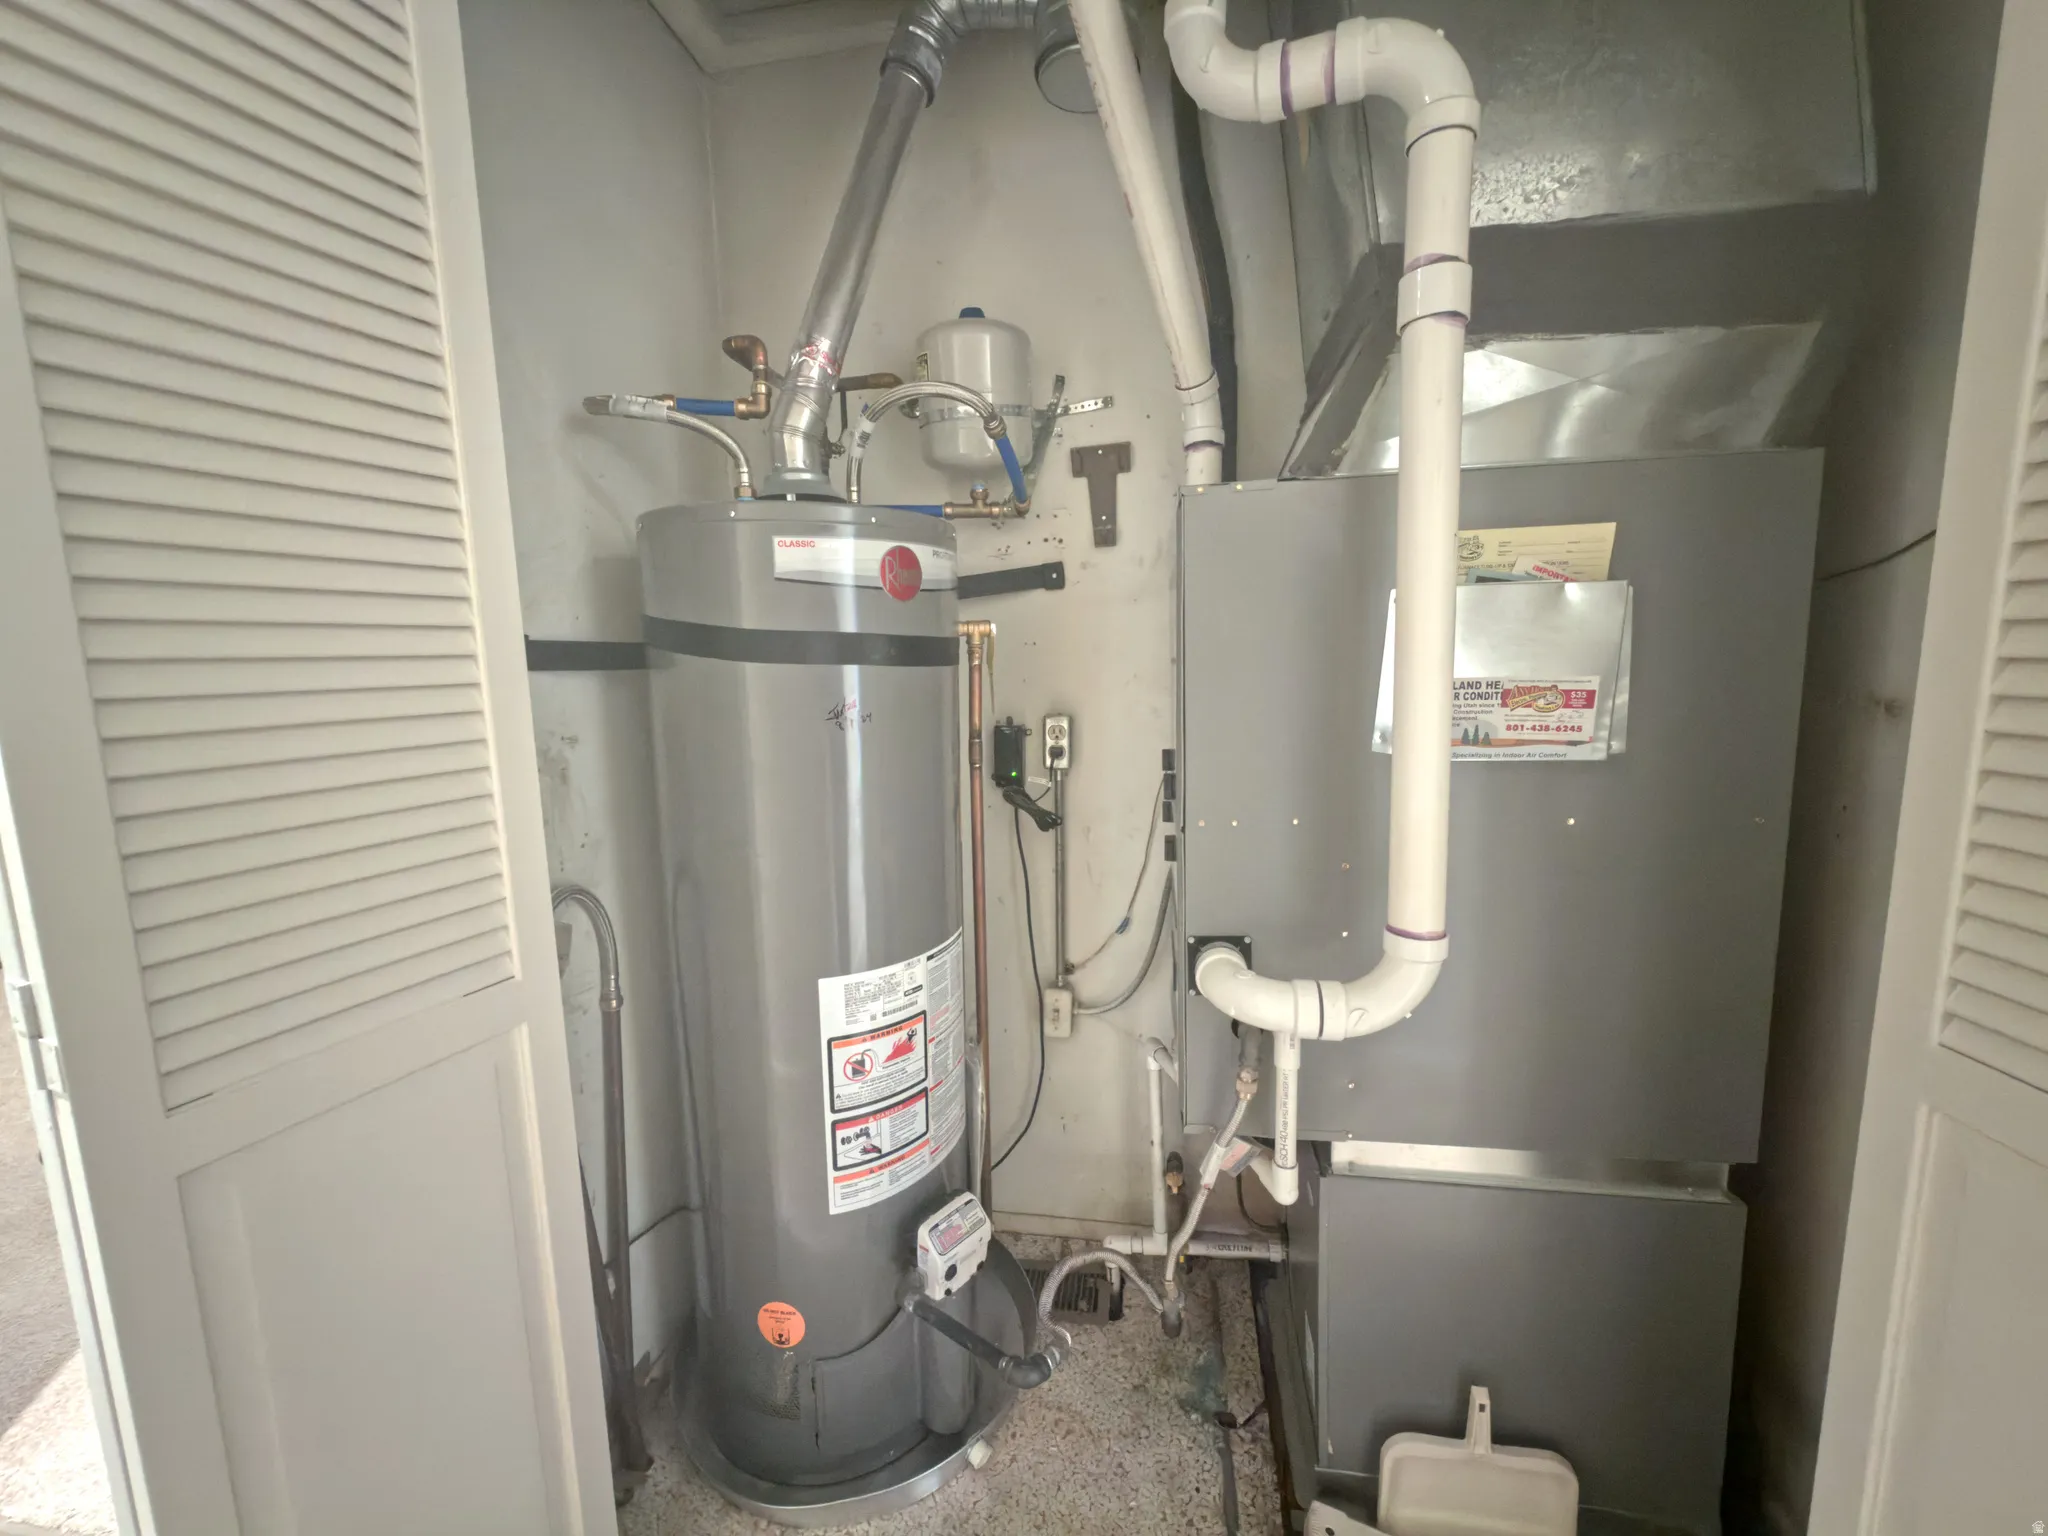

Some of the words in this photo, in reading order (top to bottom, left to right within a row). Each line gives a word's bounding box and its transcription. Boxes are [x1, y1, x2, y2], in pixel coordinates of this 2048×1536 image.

[777, 539, 816, 548] CLASSIC
[1453, 680, 1482, 691] LAND
[1570, 690, 1587, 699] $35
[1505, 723, 1583, 733] 801-438-6245
[1451, 752, 1493, 760] Specializing
[869, 1025, 904, 1040] WARNING
[875, 1104, 904, 1120] DANGER
[1280, 1131, 1289, 1143] 40
